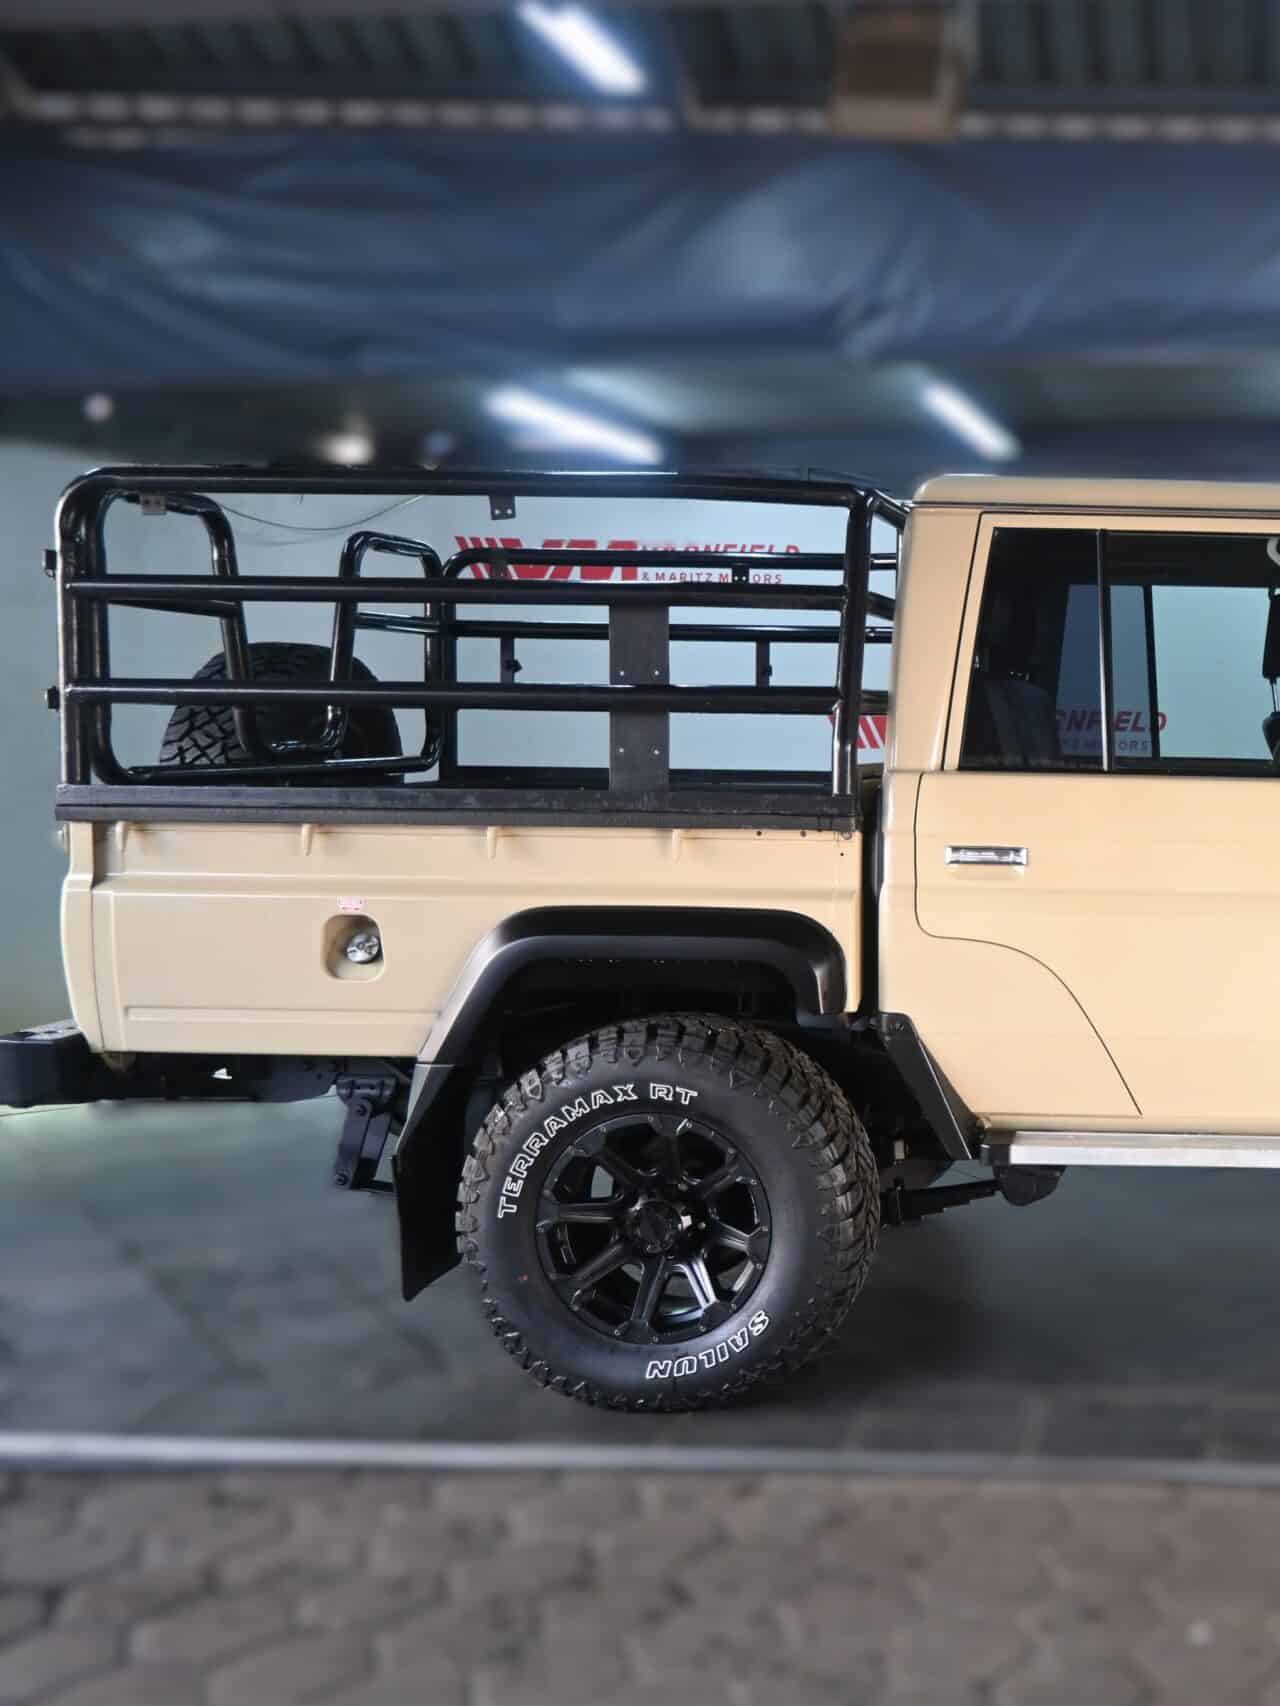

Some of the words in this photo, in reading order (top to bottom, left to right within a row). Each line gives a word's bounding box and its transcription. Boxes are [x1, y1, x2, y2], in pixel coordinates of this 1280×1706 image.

[655, 571, 713, 583] MARITZ
[719, 573, 783, 584] MORS
[498, 1083, 638, 1219] TERRAMAX
[649, 1083, 698, 1106] RT
[645, 1310, 770, 1380] SAILUN
